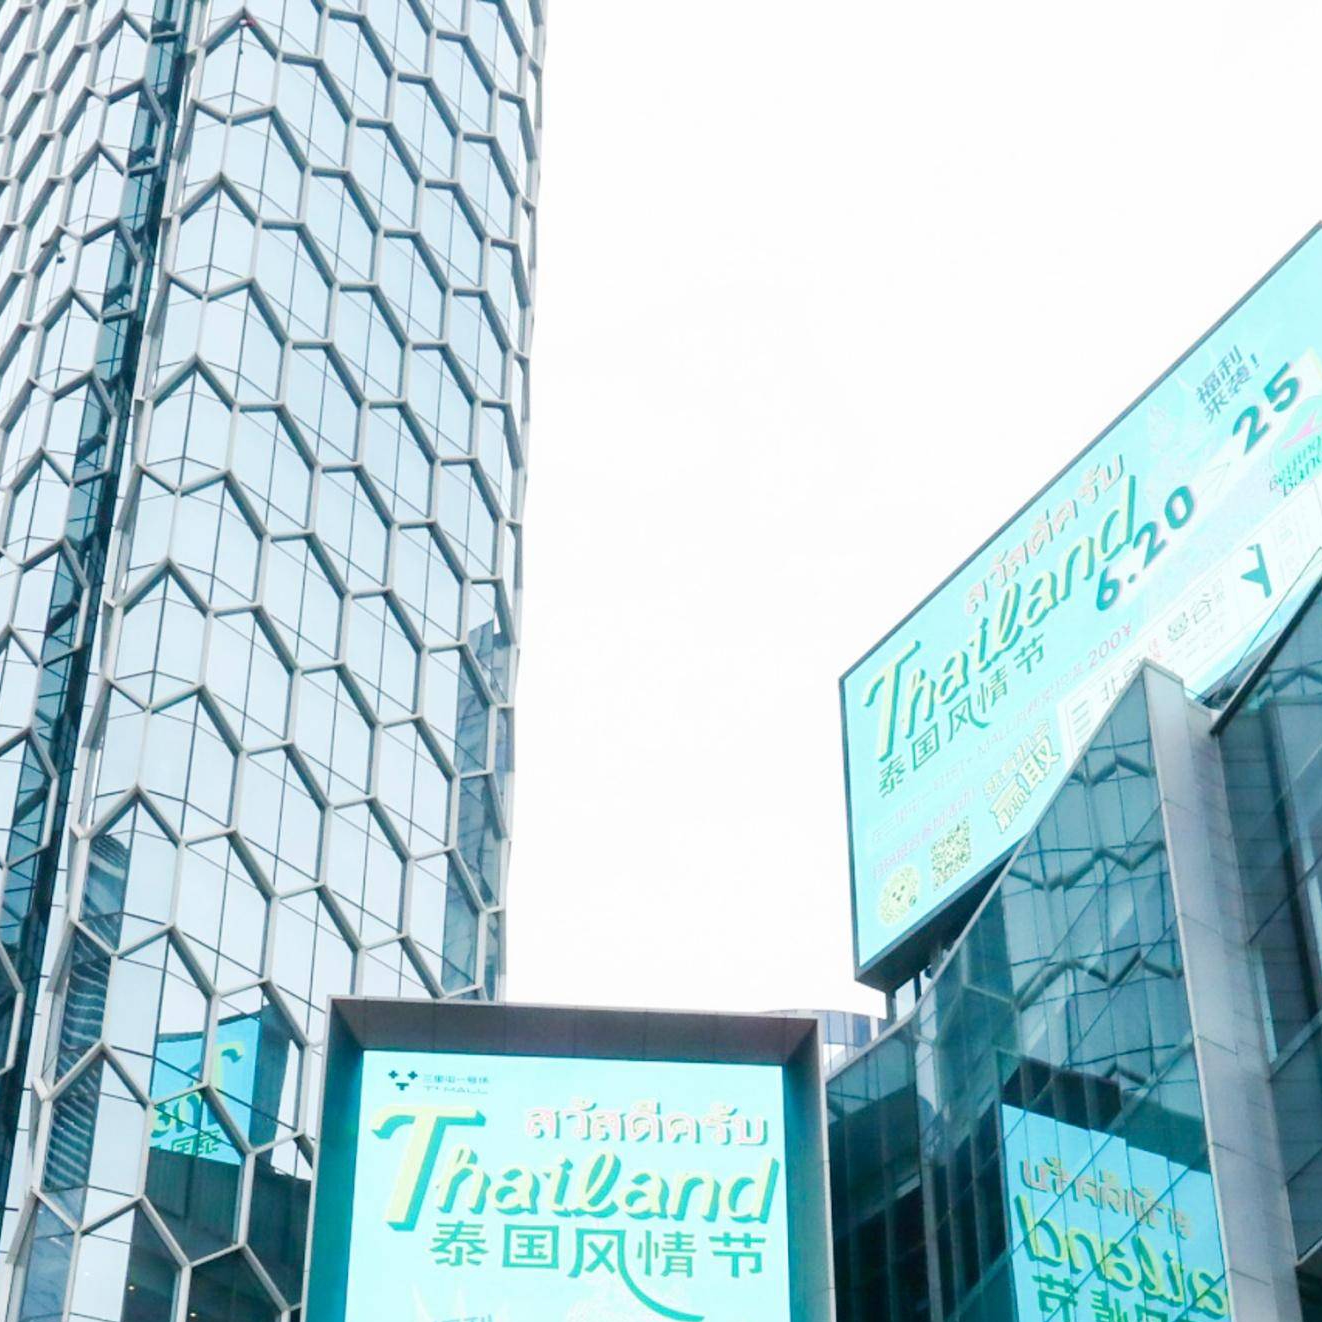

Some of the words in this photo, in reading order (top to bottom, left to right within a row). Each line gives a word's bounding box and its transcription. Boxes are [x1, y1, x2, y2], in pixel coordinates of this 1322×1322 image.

[1096, 485, 1196, 612] 6.20
[1233, 362, 1301, 455] 25
[863, 475, 1137, 762] Thailand
[878, 633, 1046, 798] 泰国风情节
[370, 1103, 780, 1232] Thailand
